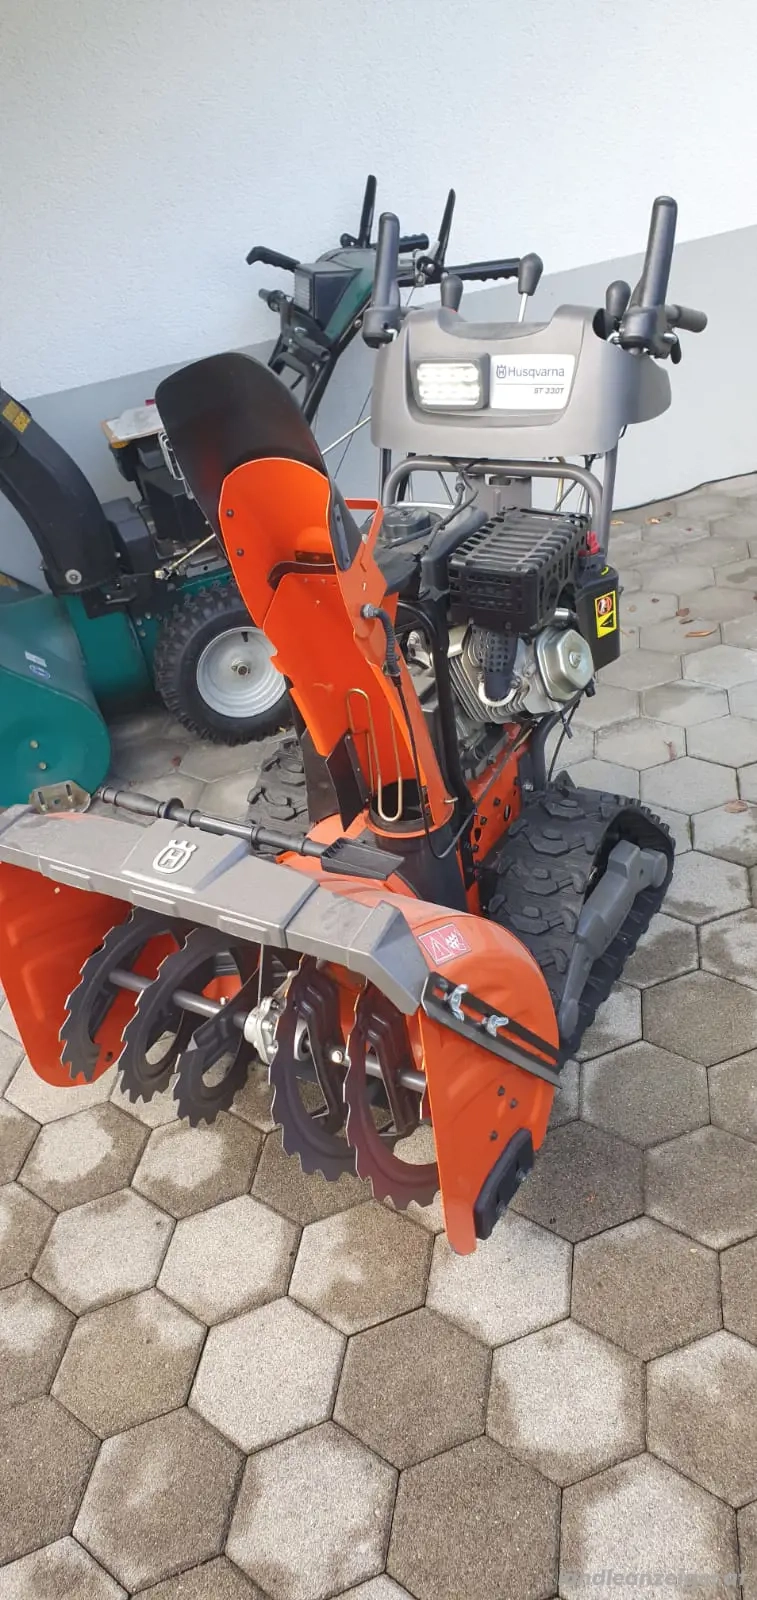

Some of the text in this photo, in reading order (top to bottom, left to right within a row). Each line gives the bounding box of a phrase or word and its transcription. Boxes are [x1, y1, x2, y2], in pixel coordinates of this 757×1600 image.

[508, 366, 565, 379] Husqvarna
[533, 387, 565, 395] ST 330T
